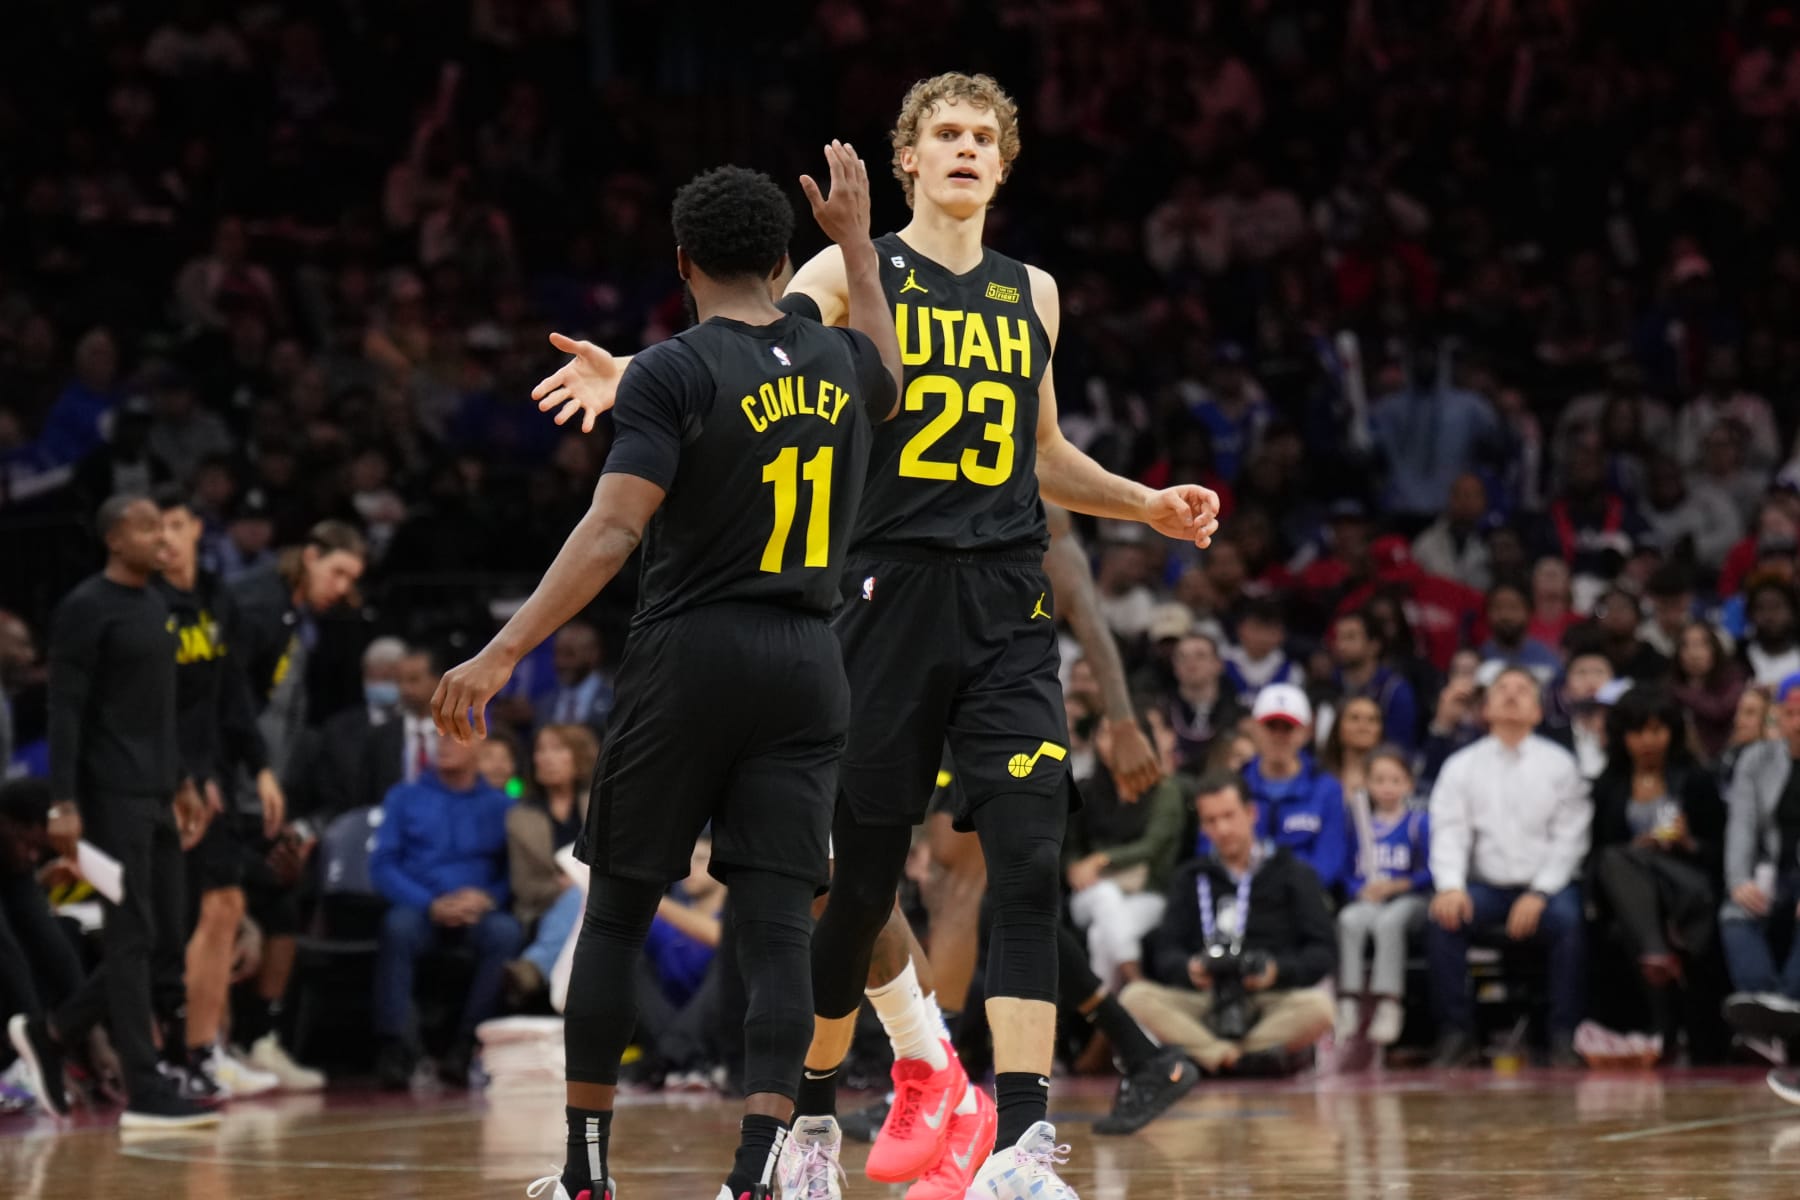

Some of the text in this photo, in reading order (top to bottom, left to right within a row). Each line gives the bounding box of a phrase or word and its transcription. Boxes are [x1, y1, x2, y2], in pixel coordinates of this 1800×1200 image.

[896, 303, 1031, 378] UTAH
[741, 376, 849, 432] CONLEY
[899, 375, 1015, 486] 23
[760, 447, 833, 573] 11
